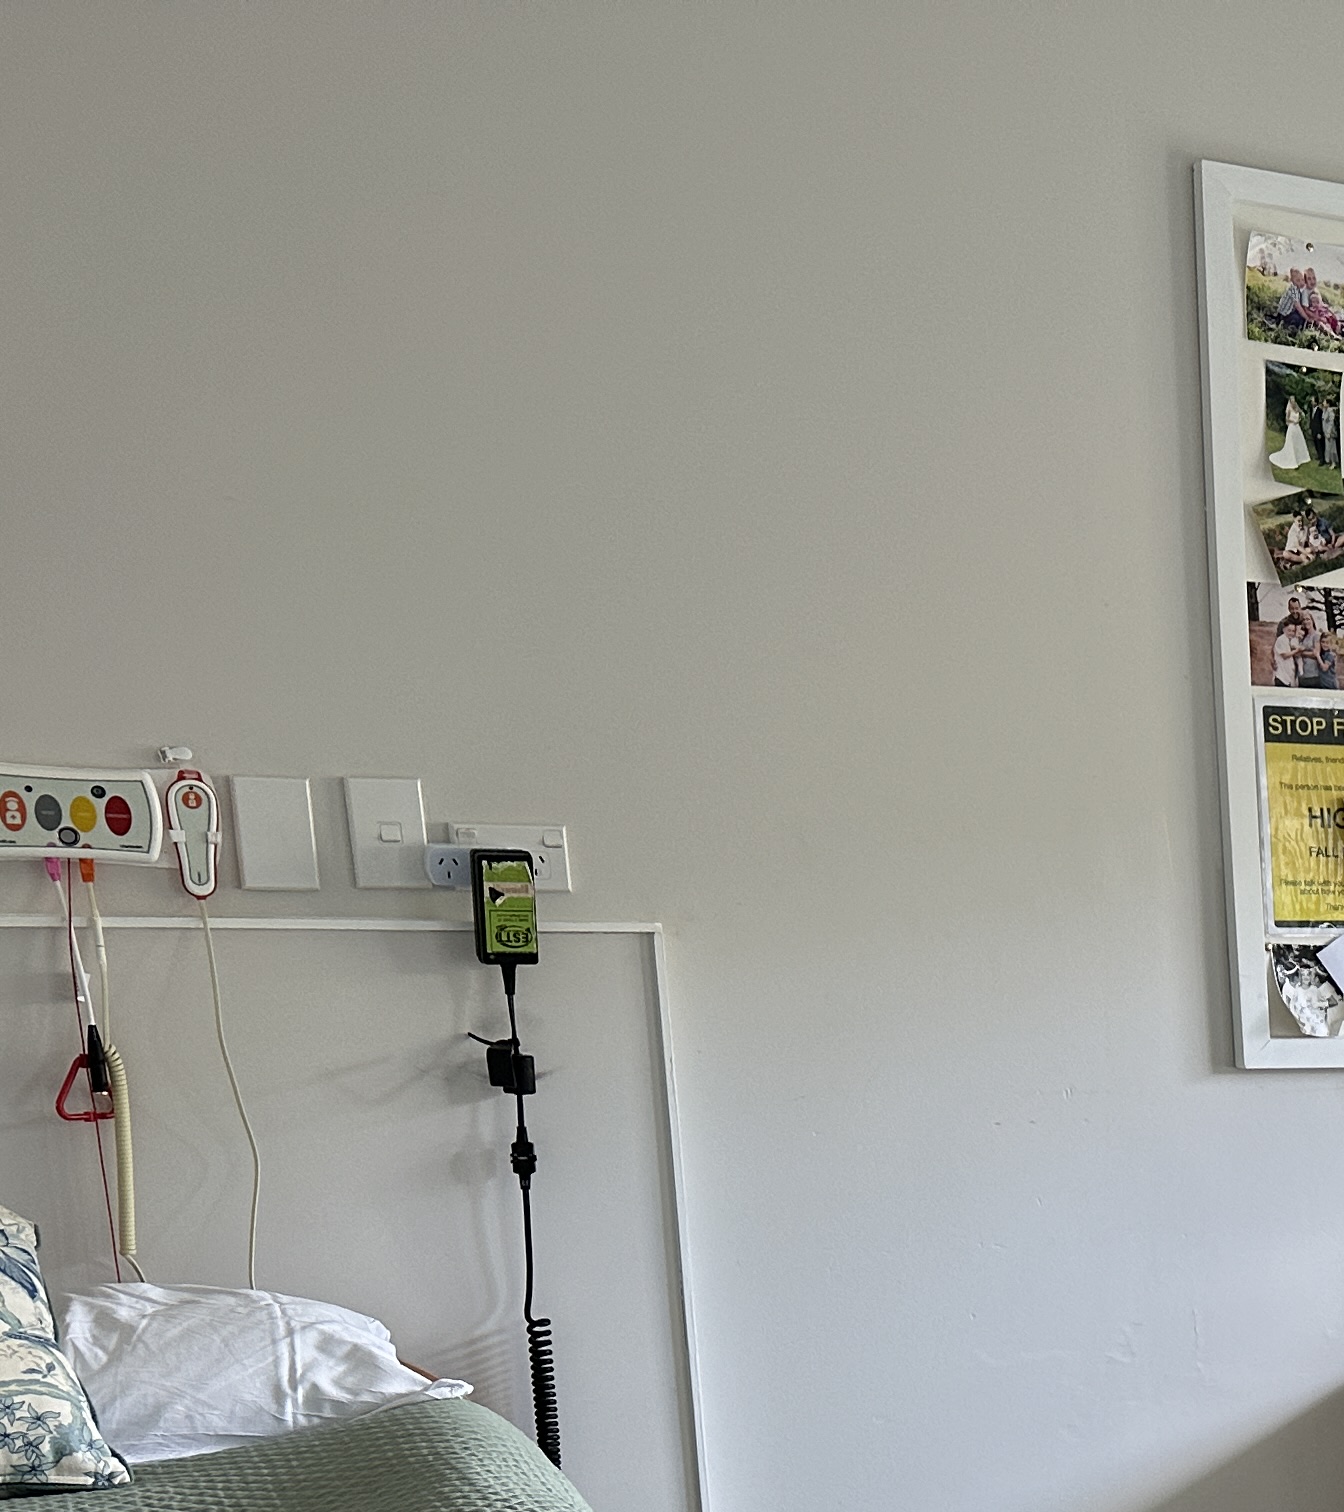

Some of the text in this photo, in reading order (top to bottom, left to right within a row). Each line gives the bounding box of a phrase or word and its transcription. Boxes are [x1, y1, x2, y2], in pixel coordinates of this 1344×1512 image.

[1268, 714, 1327, 737] STOP
[1295, 783, 1319, 792] person
[1309, 846, 1339, 858] FALL
